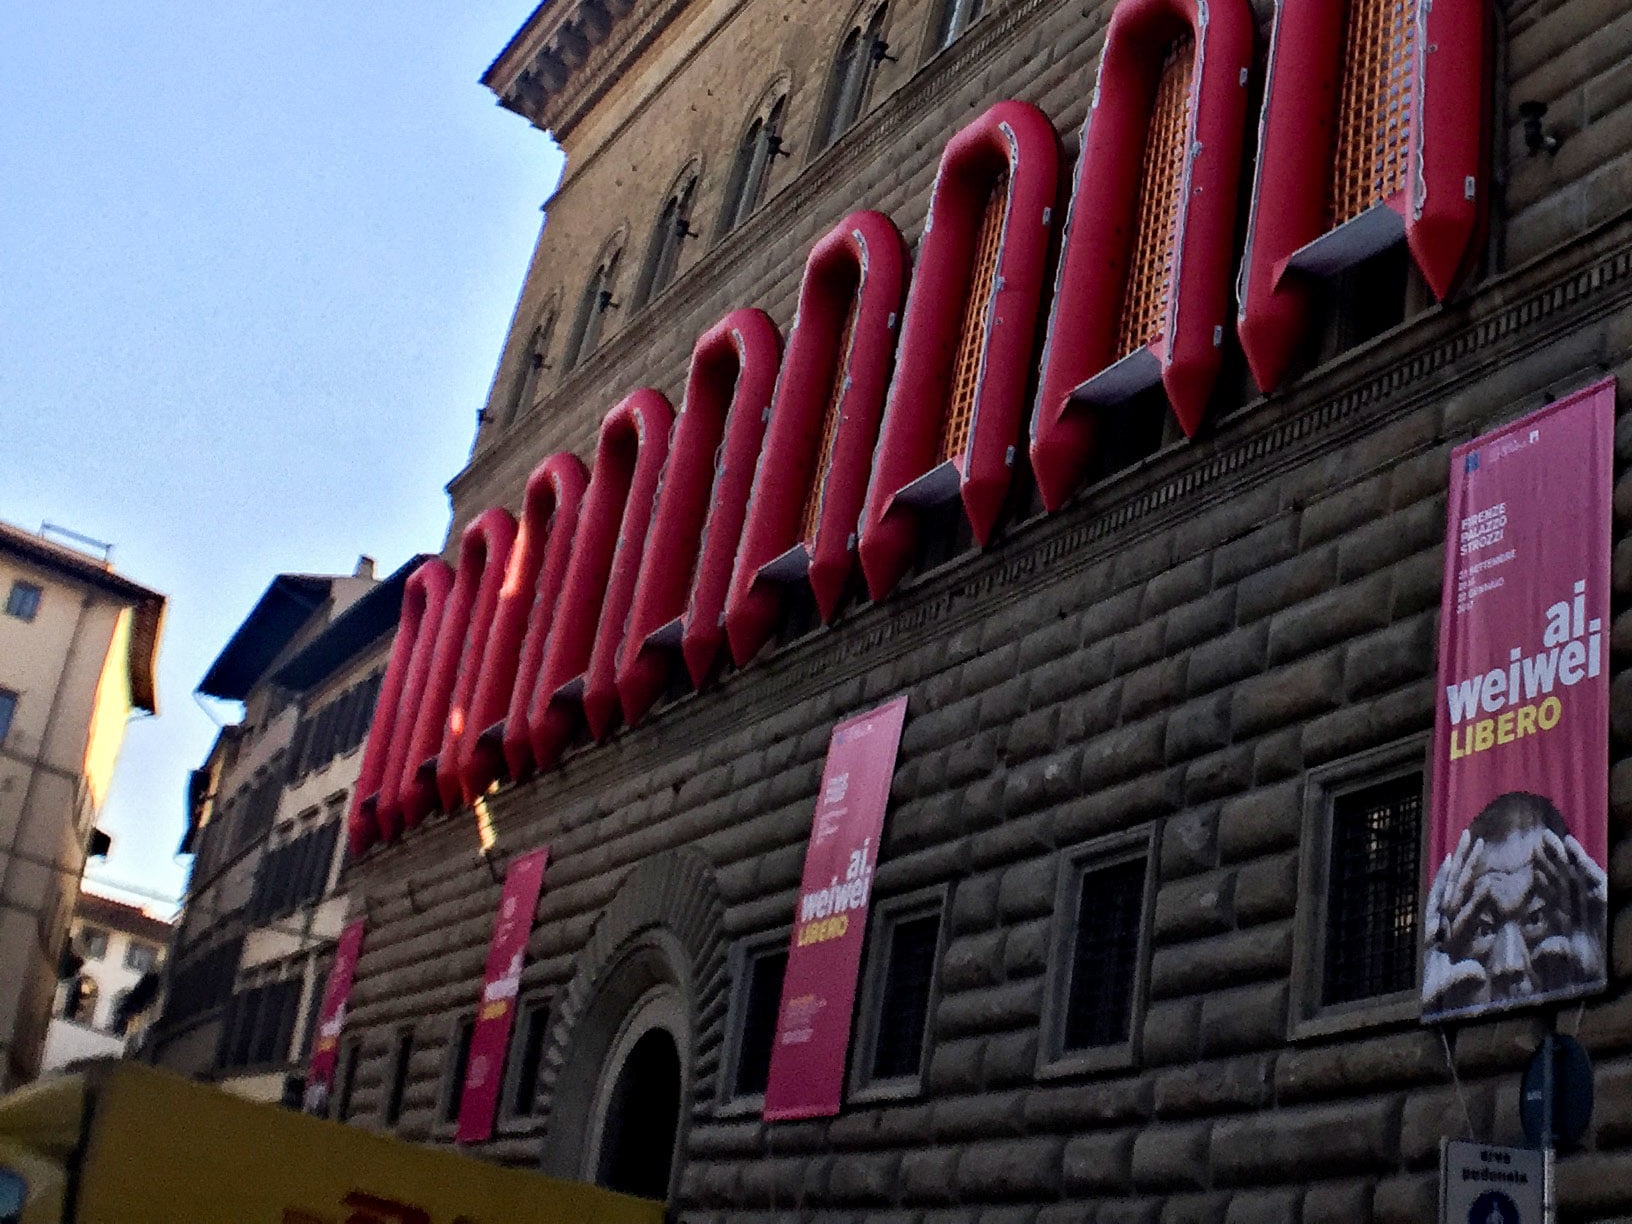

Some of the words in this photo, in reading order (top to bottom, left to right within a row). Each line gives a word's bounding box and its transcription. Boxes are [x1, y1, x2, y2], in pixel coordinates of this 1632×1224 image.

[1460, 515, 1507, 544] PALAZZO
[1460, 528, 1504, 556] STROZZI
[1543, 579, 1586, 648] ai
[1446, 618, 1601, 726] weiwei
[1449, 695, 1563, 761] LIBERO
[801, 865, 871, 923] weiwei
